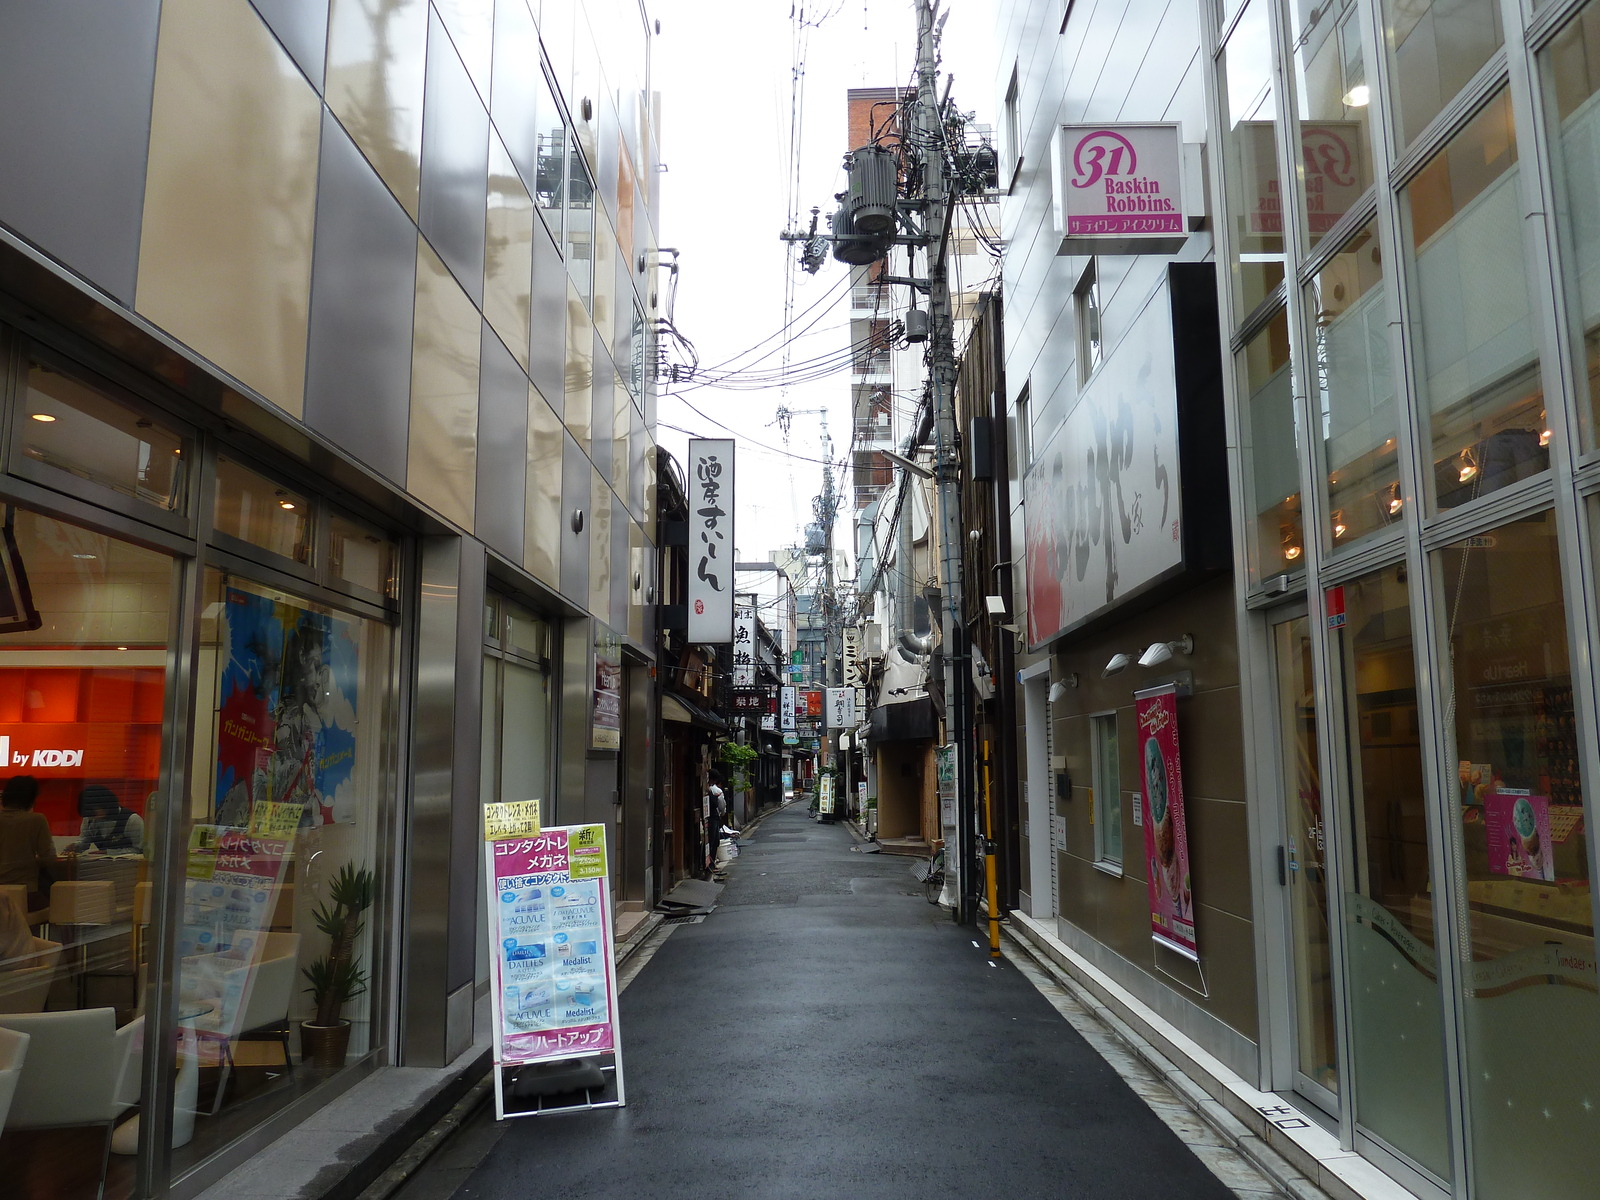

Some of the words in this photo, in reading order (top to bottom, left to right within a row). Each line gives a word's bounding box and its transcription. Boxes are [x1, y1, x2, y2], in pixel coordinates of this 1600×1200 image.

[1071, 145, 1124, 189] 31
[1104, 176, 1160, 194] Baskin
[1106, 195, 1175, 213] Robbins.
[1071, 220, 1118, 232] サーティワン
[1121, 219, 1180, 231] アイスクリーム
[12, 750, 30, 767] by
[31, 749, 84, 767] KDDI
[508, 960, 544, 970] DAILIES
[562, 957, 592, 966] Medalist
[565, 1007, 595, 1018] Medalist
[535, 1027, 605, 1050] ハートアップ
